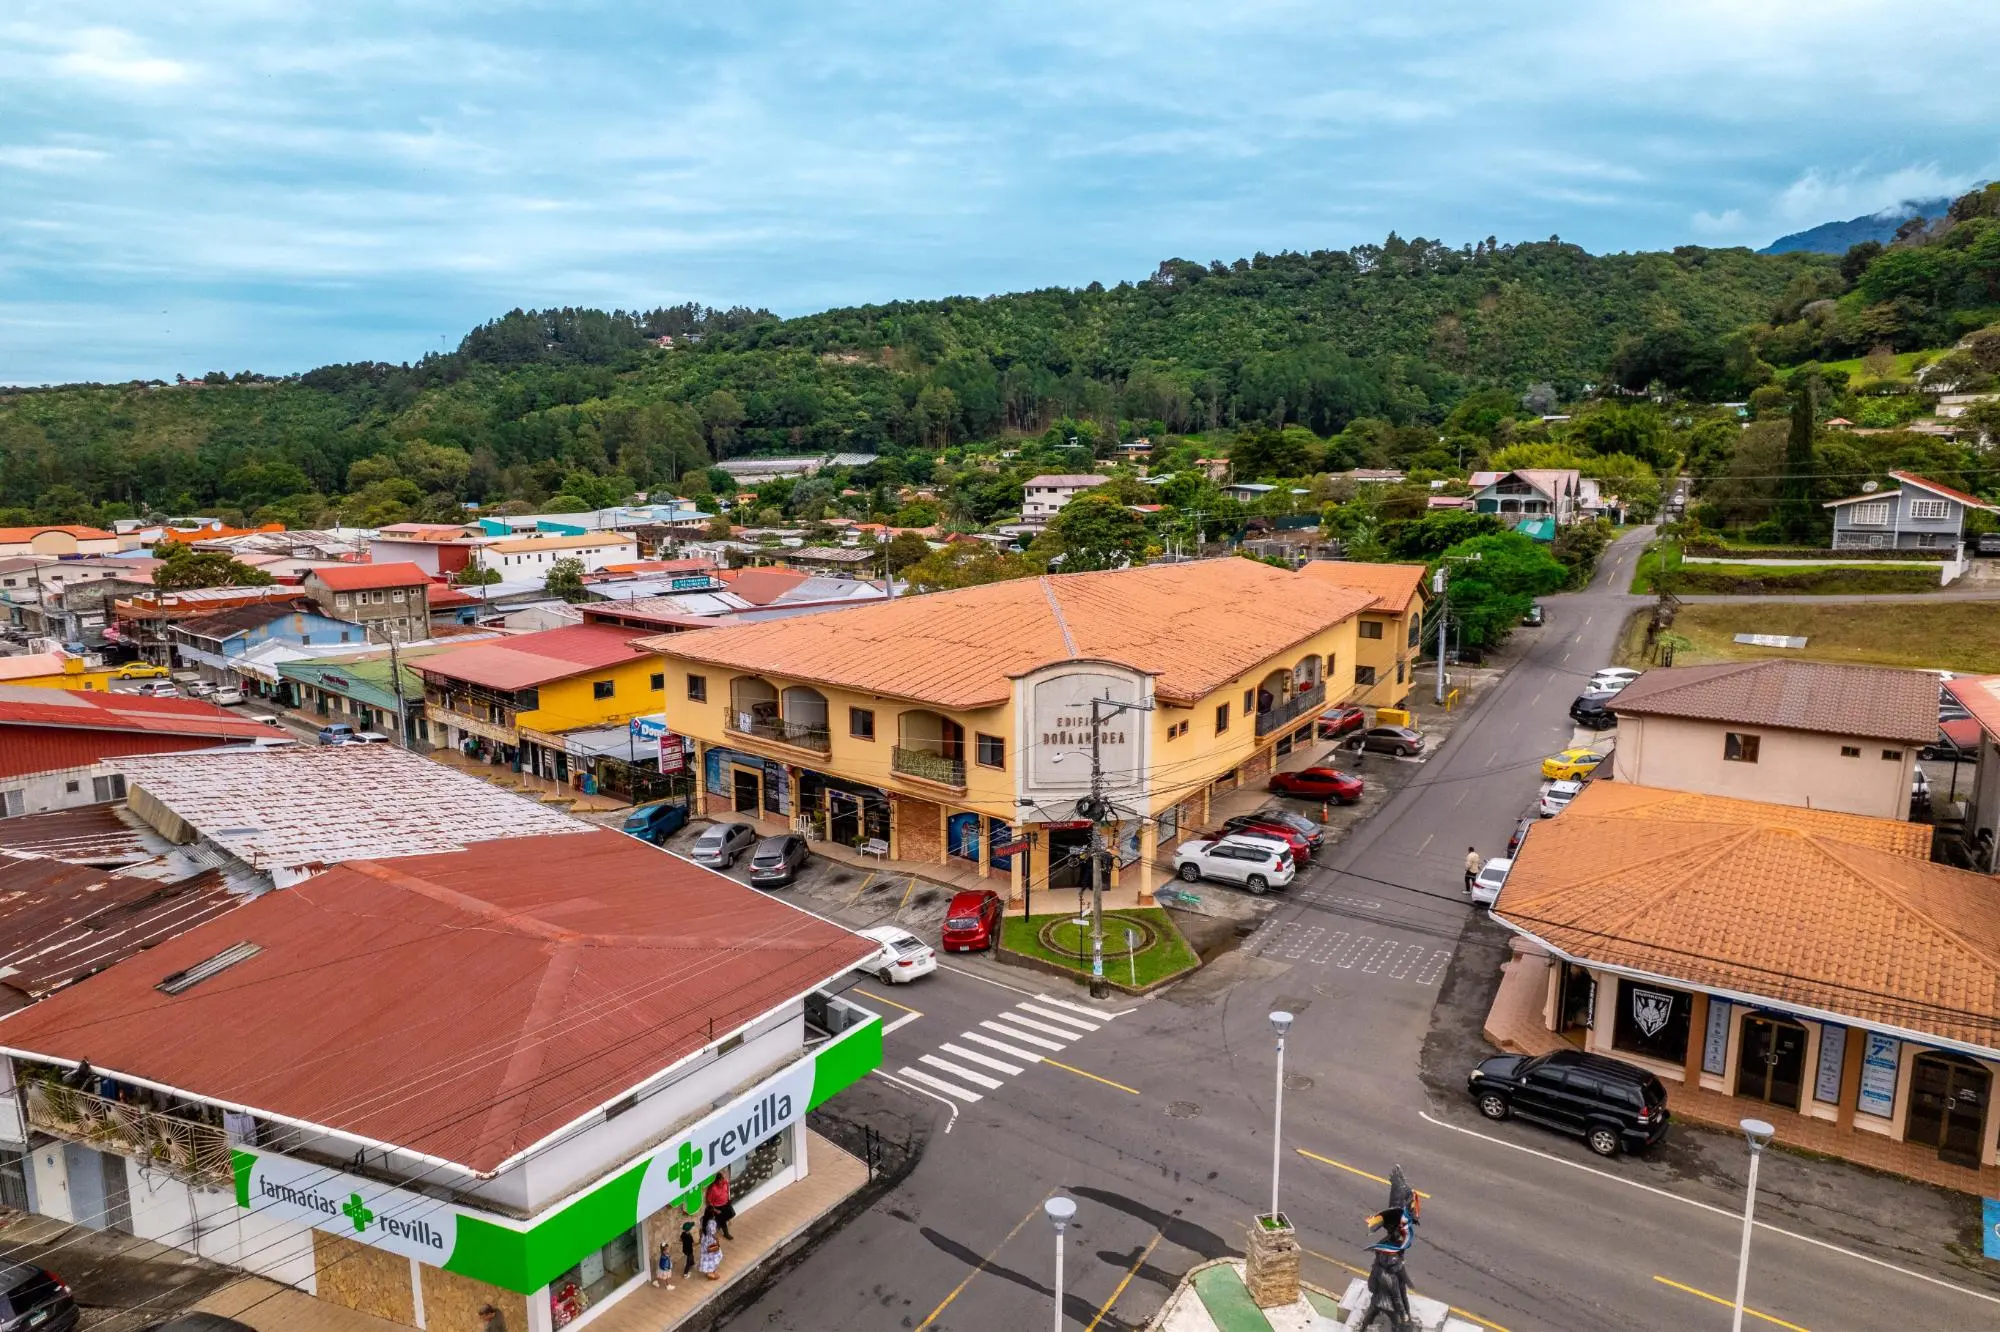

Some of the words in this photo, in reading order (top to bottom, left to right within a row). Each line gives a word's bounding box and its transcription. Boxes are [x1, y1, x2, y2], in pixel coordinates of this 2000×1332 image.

[1043, 731, 1073, 745] DOÑA
[1078, 732, 1125, 744] ANREA
[1057, 717, 1110, 727] EDIFIO
[708, 1093, 792, 1167] revilla
[259, 1174, 337, 1216] farmacias
[379, 1215, 443, 1259] revilla
